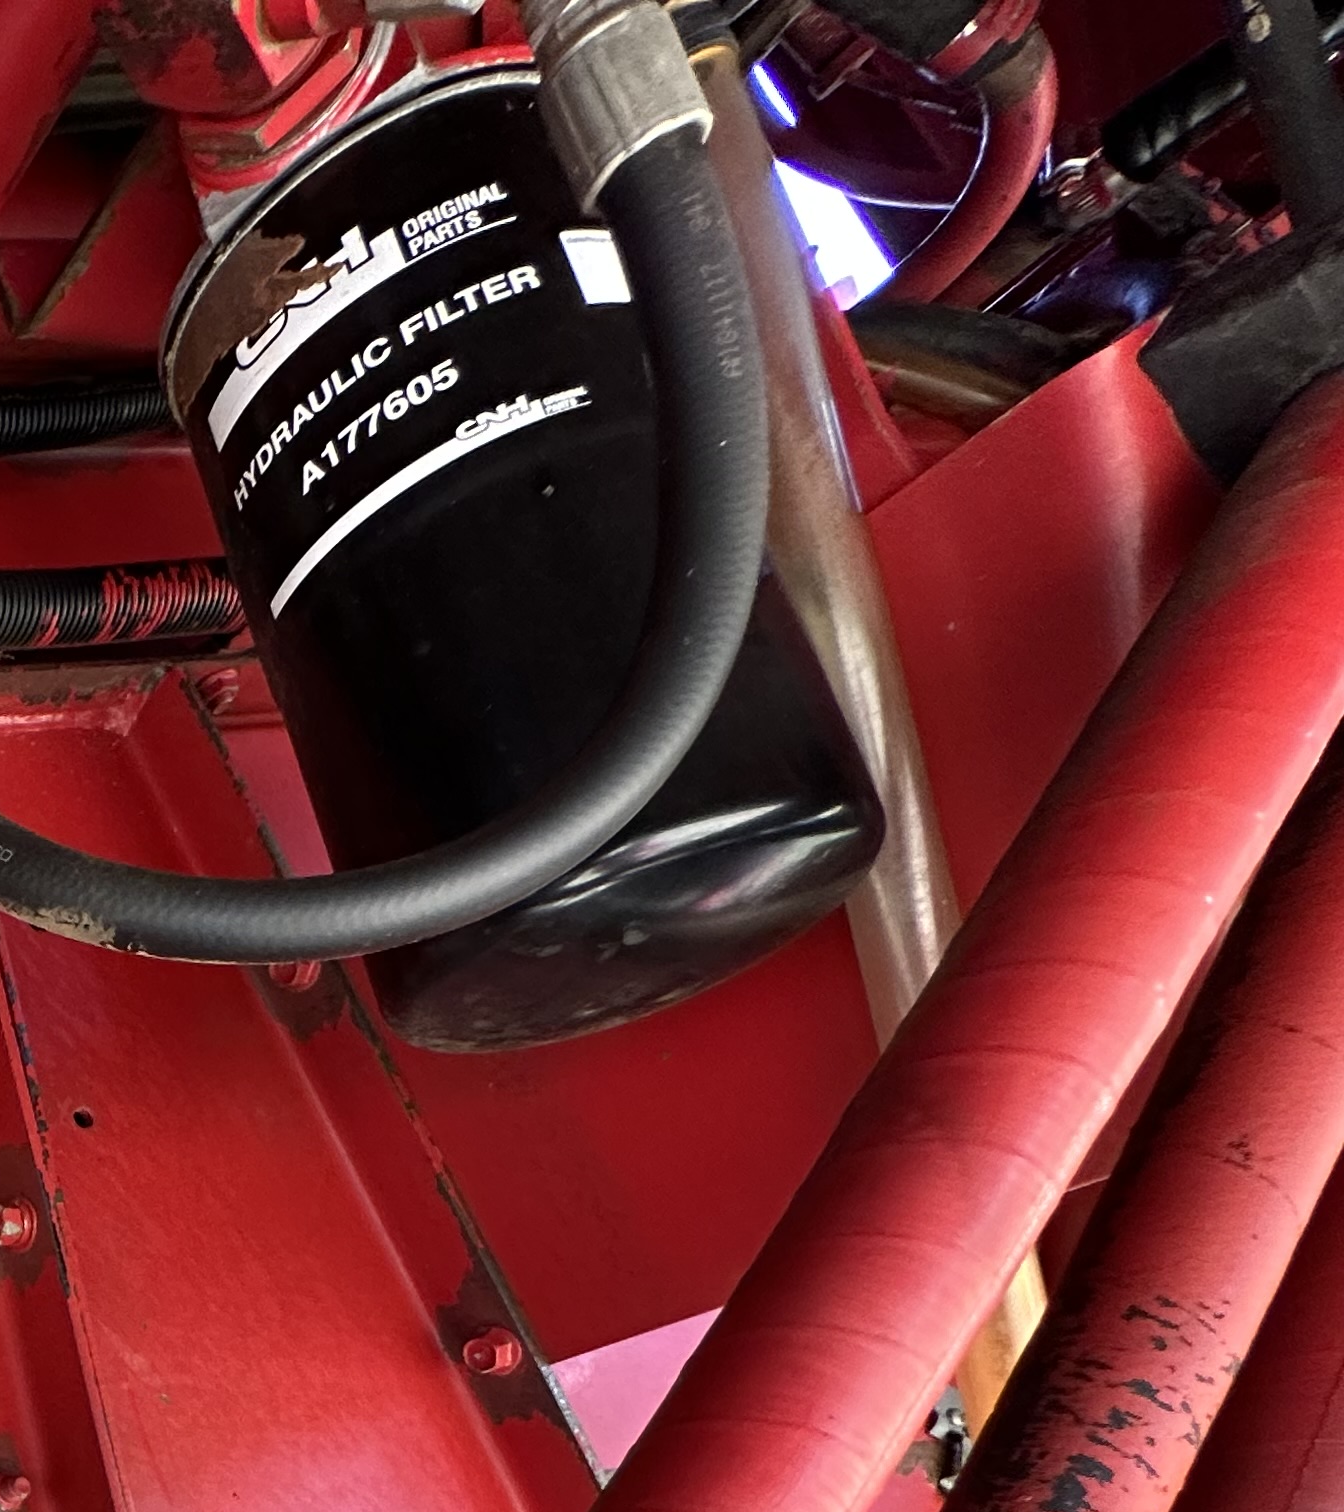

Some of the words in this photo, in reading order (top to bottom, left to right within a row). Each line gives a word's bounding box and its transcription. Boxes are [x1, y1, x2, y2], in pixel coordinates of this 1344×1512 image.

[402, 182, 508, 239] ORIGINAL
[408, 210, 484, 257] PARTS
[233, 337, 392, 511] HYDRAULIC
[399, 265, 541, 346] FILTER
[302, 359, 460, 496] A177605
